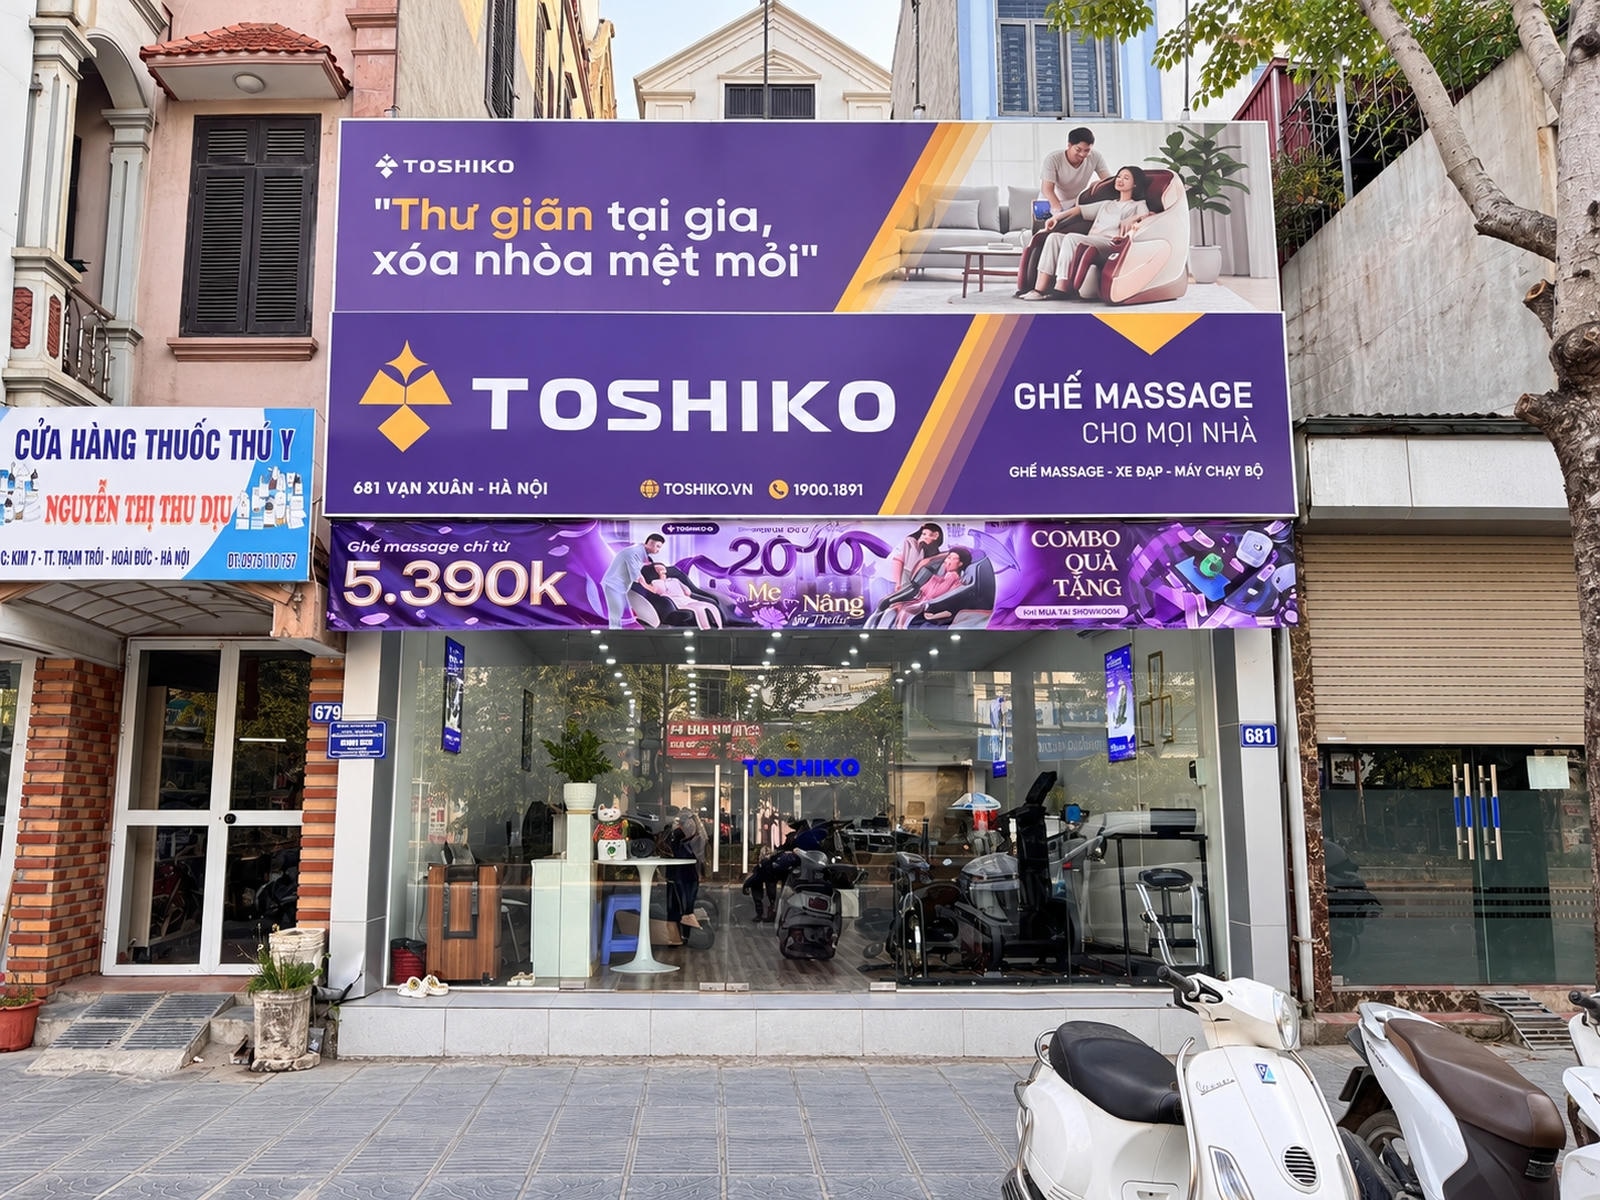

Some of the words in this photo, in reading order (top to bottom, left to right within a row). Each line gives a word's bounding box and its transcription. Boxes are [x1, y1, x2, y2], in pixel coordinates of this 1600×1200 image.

[403, 159, 514, 174] TOSHIKO
[375, 197, 479, 231] "Thư
[491, 198, 592, 240] giãn
[607, 198, 669, 240] tại
[683, 198, 773, 240] gia,
[371, 242, 458, 276] xóa
[474, 242, 592, 276] nhòa
[609, 245, 700, 286] mệt
[714, 241, 818, 278] mỏi"
[1013, 369, 1083, 410] GHẾ
[1095, 381, 1253, 410] MASSAGE
[472, 377, 896, 433] TOSHIKO
[15, 417, 62, 461] CỬA
[70, 421, 137, 461] HÀNG
[145, 417, 220, 461] THUỐC
[229, 420, 274, 461] THÚ
[279, 428, 295, 461] Y
[1082, 421, 1137, 444] CHO
[1147, 421, 1192, 447] MỌI
[1202, 415, 1257, 443] NHÀ
[1009, 462, 1037, 478] GHẾ
[1040, 466, 1104, 478] MASSAGE
[1115, 466, 1132, 477] XE
[1136, 466, 1163, 480] ĐẠP
[1174, 462, 1202, 477] MÁY
[1205, 465, 1241, 480] CHẠY
[1244, 462, 1264, 480] BỘ
[353, 481, 380, 496] 681
[385, 481, 424, 499] VẠN
[427, 477, 474, 496] XUÂN
[488, 476, 511, 496] HÀ
[514, 477, 548, 499] NỘI
[663, 482, 753, 497] TOSHIKO.VN
[793, 482, 864, 497] 1900.1891
[44, 479, 121, 524] NGUYỄN
[124, 495, 155, 532] THỊ
[159, 495, 196, 524] THU
[199, 495, 233, 532] DỊU
[347, 538, 381, 553] Ghế
[384, 541, 460, 555] massage
[491, 540, 512, 553] từ
[1031, 529, 1121, 548] COMBO
[11, 550, 28, 566] KIM
[30, 550, 36, 566] 7
[44, 550, 55, 566] TT.
[58, 550, 82, 569] TRẠM
[1065, 549, 1119, 574] QUÀ
[343, 559, 568, 607] 5.390k
[1053, 574, 1122, 601] TẶNG
[314, 705, 341, 721] 679
[1245, 728, 1272, 744] 681
[742, 757, 861, 778] TOSHIKO
